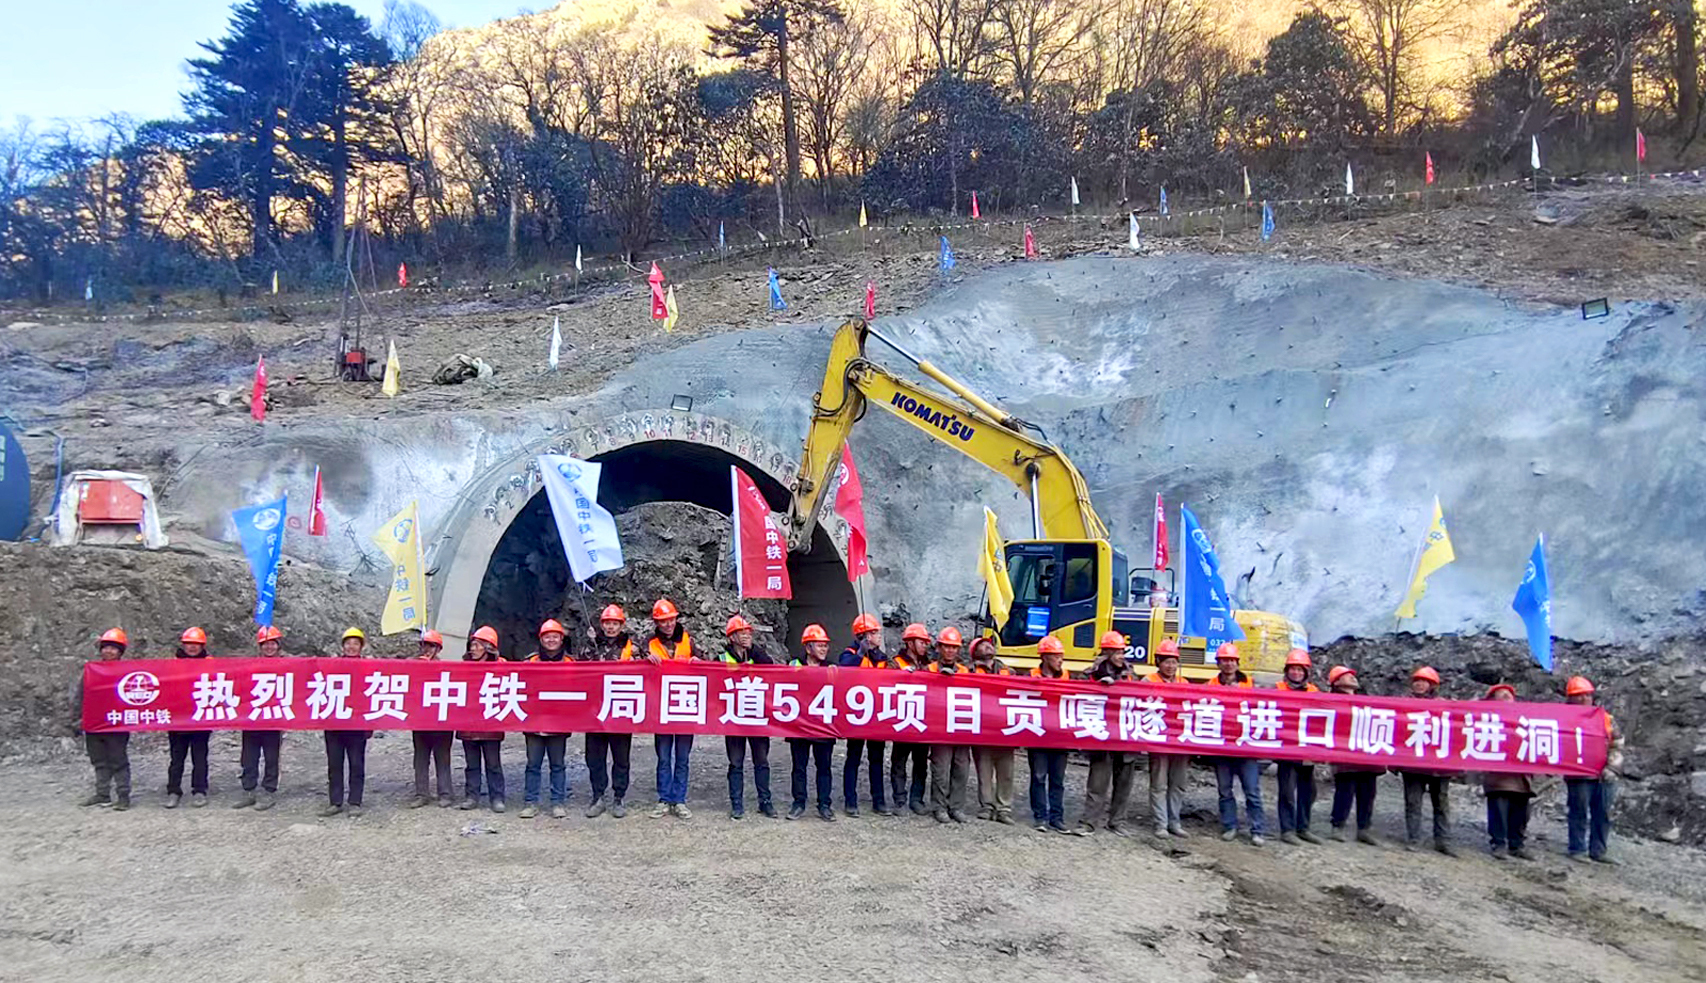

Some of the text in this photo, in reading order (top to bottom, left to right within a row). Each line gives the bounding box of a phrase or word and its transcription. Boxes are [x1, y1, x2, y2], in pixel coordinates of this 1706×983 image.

[891, 392, 975, 441] KOMATSU
[644, 429, 656, 439] 10
[664, 428, 673, 437] 11
[685, 431, 697, 440] 12
[738, 445, 748, 455] 15
[107, 709, 171, 725] 中国中铁
